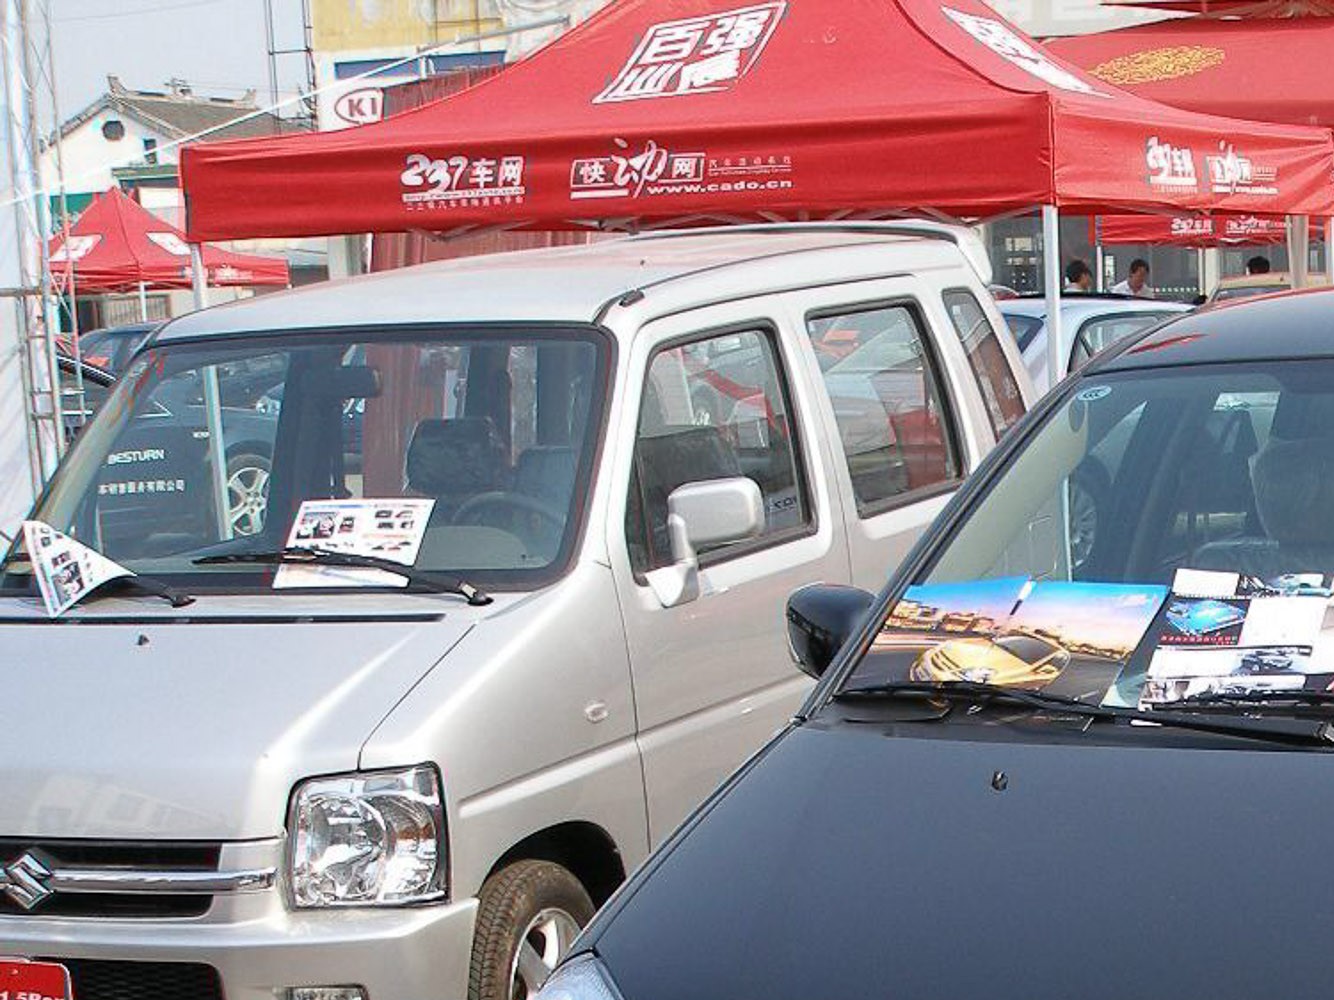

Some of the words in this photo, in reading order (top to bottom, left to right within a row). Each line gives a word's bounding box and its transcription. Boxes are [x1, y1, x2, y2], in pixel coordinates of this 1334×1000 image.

[637, 9, 773, 66] 百强
[647, 180, 792, 194] www.cado.cn
[108, 449, 165, 465] BESTURN
